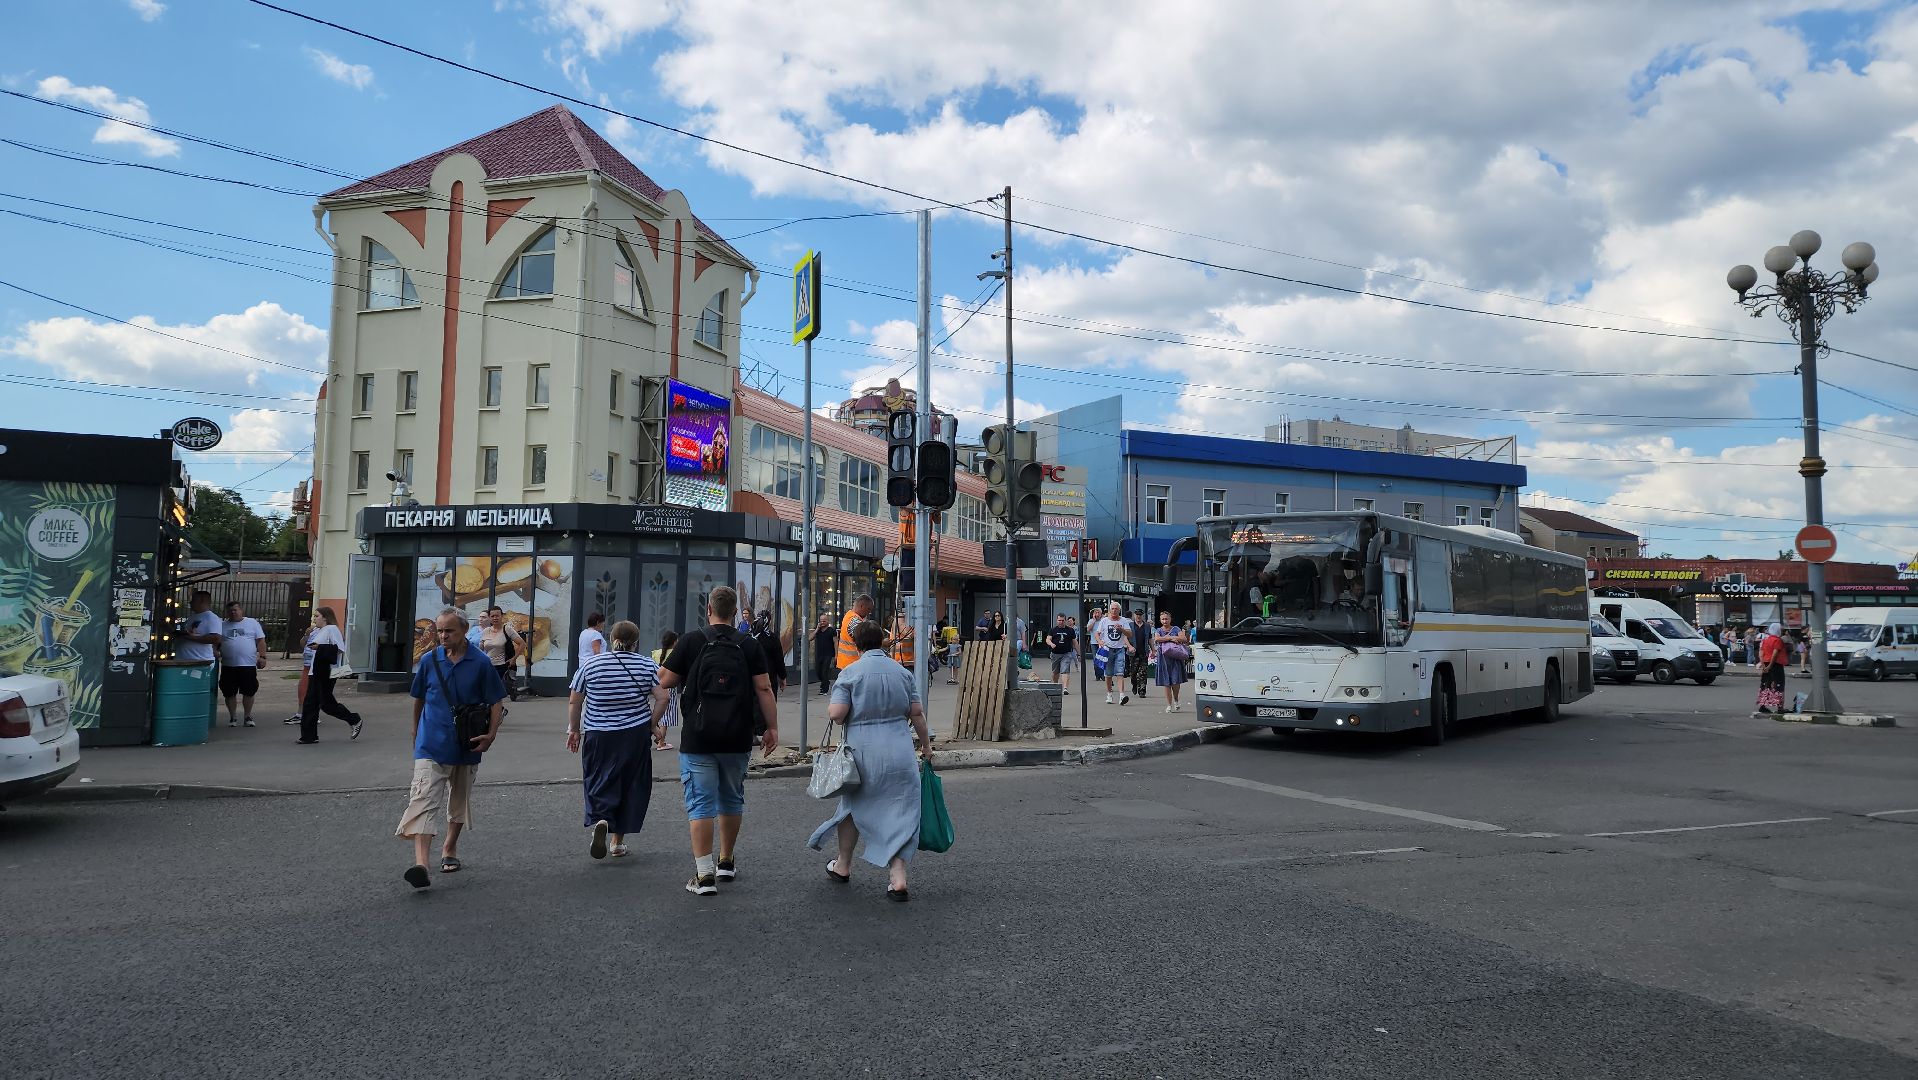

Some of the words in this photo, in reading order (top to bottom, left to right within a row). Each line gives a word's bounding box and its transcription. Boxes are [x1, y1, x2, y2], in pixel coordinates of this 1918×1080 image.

[1041, 464, 1066, 482] FC
[385, 510, 454, 527] ПЕКАРНЯ
[465, 508, 553, 528] МЕЛЬНИЦА
[44, 519, 76, 530] MAKE
[39, 531, 79, 543] COFFEE
[1606, 569, 1701, 580] СКУПКА-РЕМОНТ
[1721, 581, 1757, 592] cofix
